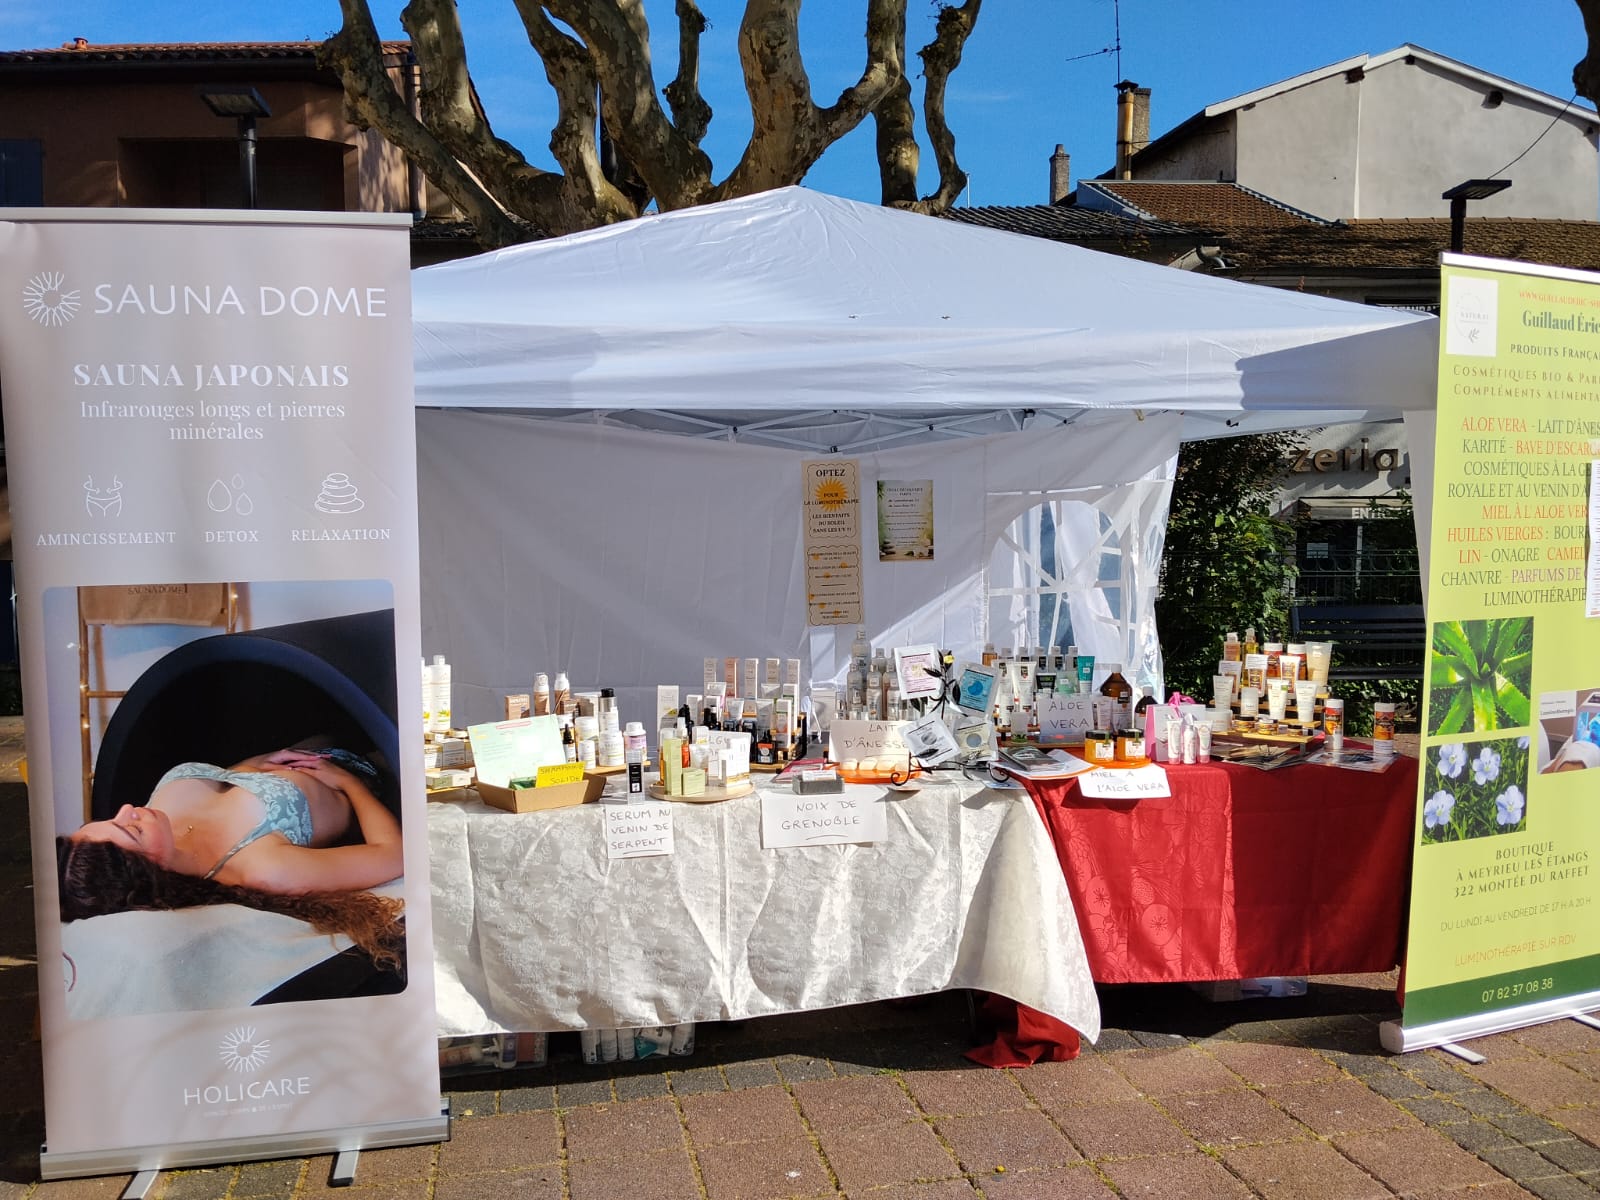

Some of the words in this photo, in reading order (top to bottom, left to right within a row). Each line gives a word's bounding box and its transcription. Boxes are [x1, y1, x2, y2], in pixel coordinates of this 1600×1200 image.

[94, 283, 245, 316] SAUNA
[260, 286, 387, 317] DOME
[1522, 309, 1574, 332] Guillaud
[1510, 343, 1559, 357] PRODUITS
[73, 363, 184, 387] SAUNA
[194, 364, 349, 391] JAPONAIS
[1454, 364, 1537, 383] COSMÉTIQUES
[1542, 371, 1562, 381] BIO
[1567, 371, 1574, 382] &
[1454, 383, 1541, 399] COMPLÉMENTS
[80, 400, 195, 421] Infrarouges
[199, 400, 251, 421] longs
[256, 402, 273, 418] et
[279, 402, 345, 421] pierres
[169, 422, 264, 441] minérales
[1461, 416, 1495, 433] ALOE
[1498, 416, 1527, 433] VERA
[1538, 418, 1564, 434] LAIT
[1463, 437, 1506, 454] KARITÉ
[1516, 439, 1544, 455] BAVE
[1289, 437, 1399, 473] zeria
[815, 469, 846, 477] OPTEZ
[1464, 459, 1549, 480] COSMÉTIQUES
[1552, 459, 1561, 477] À
[1562, 461, 1577, 477] LA
[1448, 482, 1496, 498] ROYALE
[1499, 483, 1513, 498] ET
[1515, 483, 1531, 498] AU
[1533, 483, 1570, 498] VENIN
[1483, 504, 1511, 520] MIEL
[36, 531, 176, 547] AMINCISSEMENT
[204, 530, 260, 543] DETOX
[291, 528, 391, 542] RELAXATION
[1448, 527, 1493, 543] HUILES
[1497, 526, 1543, 542] VIERGES
[1459, 549, 1481, 564] LIN
[1491, 547, 1540, 563] ONAGRE
[1441, 570, 1502, 587] CHANVRE
[1511, 567, 1565, 583] PARFUMS
[1567, 567, 1582, 582] DE
[1484, 586, 1587, 607] LUMINOTHÉRAPIE
[1048, 701, 1085, 712] ALOE
[868, 724, 897, 732] LAIT
[1049, 718, 1090, 729] VERA
[551, 776, 581, 785] SOLIDE
[1137, 782, 1165, 791] VERA
[796, 800, 827, 811] NOIX
[838, 799, 857, 809] DE
[610, 810, 651, 821] SERUM
[781, 816, 861, 831] GRENOBLE
[611, 825, 647, 834] VENIN
[653, 823, 669, 831] DE
[611, 837, 668, 849] SERPENT
[1496, 841, 1555, 860] BOUTIQUE
[1456, 868, 1463, 882] À
[1468, 863, 1520, 881] MEYRIEU
[1524, 858, 1543, 871] LES
[1454, 884, 1474, 898] 322
[1479, 876, 1526, 894] MONTÉE
[1530, 873, 1545, 885] DU
[1550, 865, 1590, 881] RAFFET
[1441, 921, 1453, 932] DU
[1456, 916, 1483, 929] LUNDI
[1484, 913, 1495, 924] AU
[1498, 905, 1537, 921] VENDREDI
[1539, 903, 1550, 913] DE
[1551, 901, 1560, 912] 17
[1539, 936, 1556, 950] SUR
[1559, 933, 1577, 946] RDV
[1482, 990, 1495, 1003] 07
[1497, 986, 1510, 1000] 82
[1512, 983, 1524, 997] 37
[1525, 980, 1539, 992] 08
[1541, 977, 1553, 990] 38
[183, 1076, 311, 1106] HOLICARE
